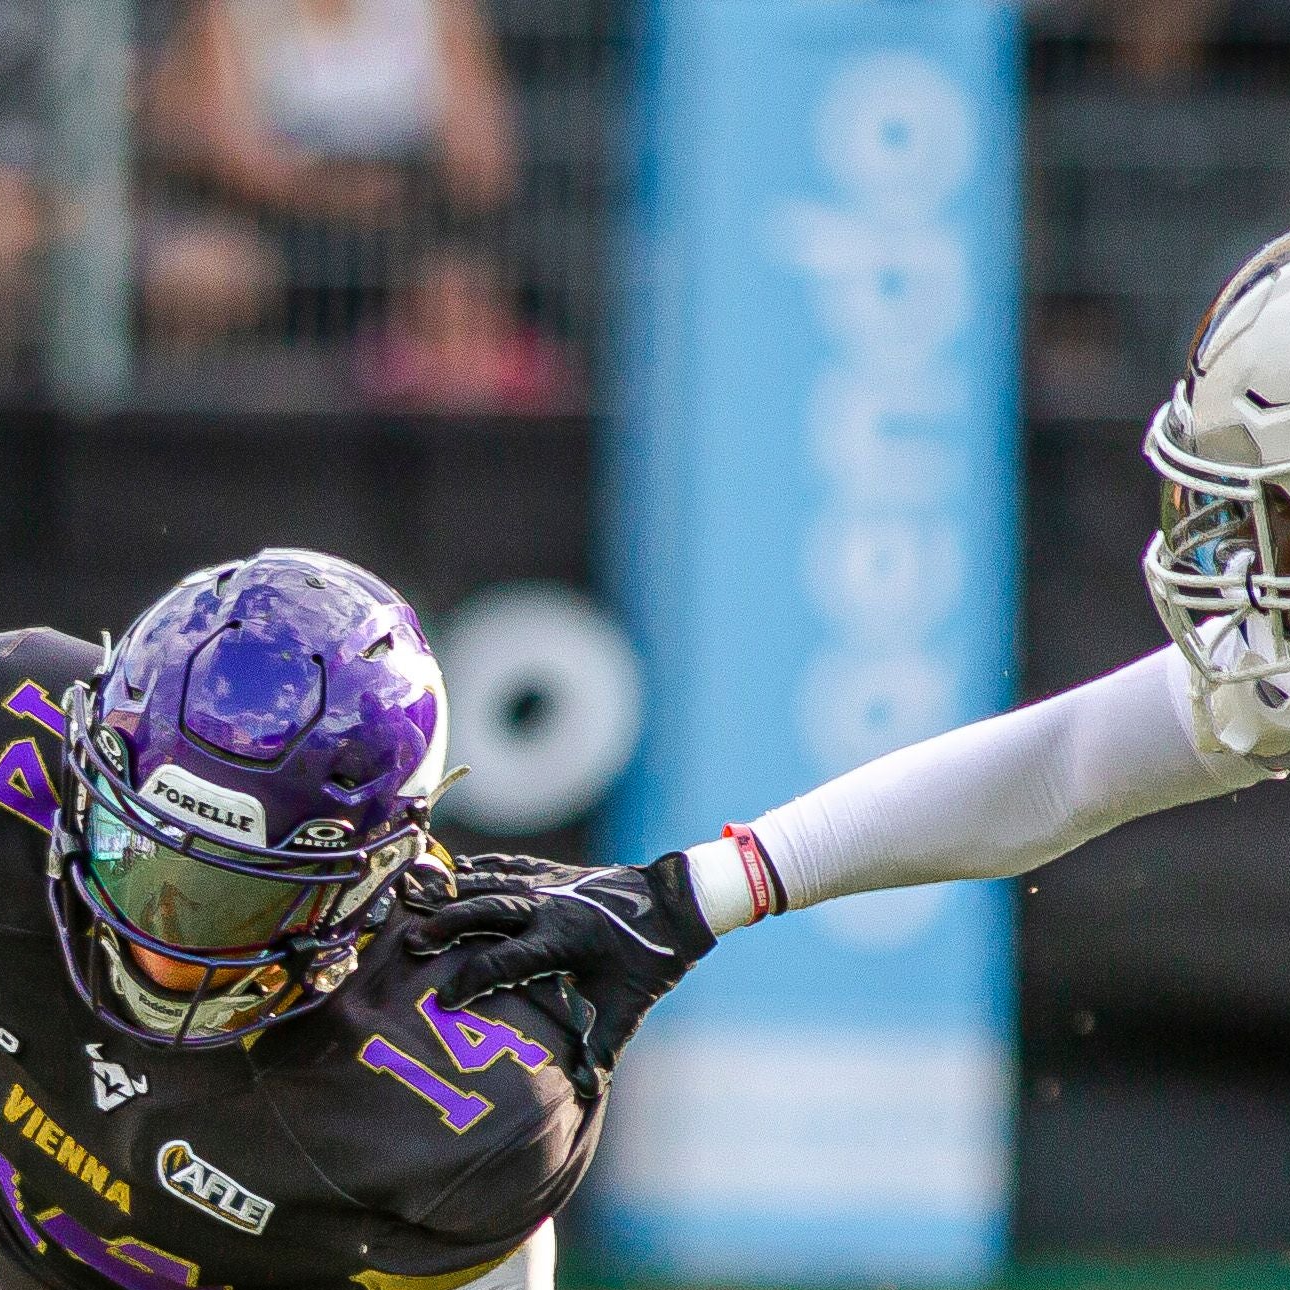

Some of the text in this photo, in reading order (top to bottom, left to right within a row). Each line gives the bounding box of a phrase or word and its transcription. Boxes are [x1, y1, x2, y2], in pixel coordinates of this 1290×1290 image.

[153, 780, 255, 833] FORELLE
[358, 987, 555, 1136] 14
[3, 1083, 132, 1216] VIENNA
[170, 1161, 268, 1227] AFLE
